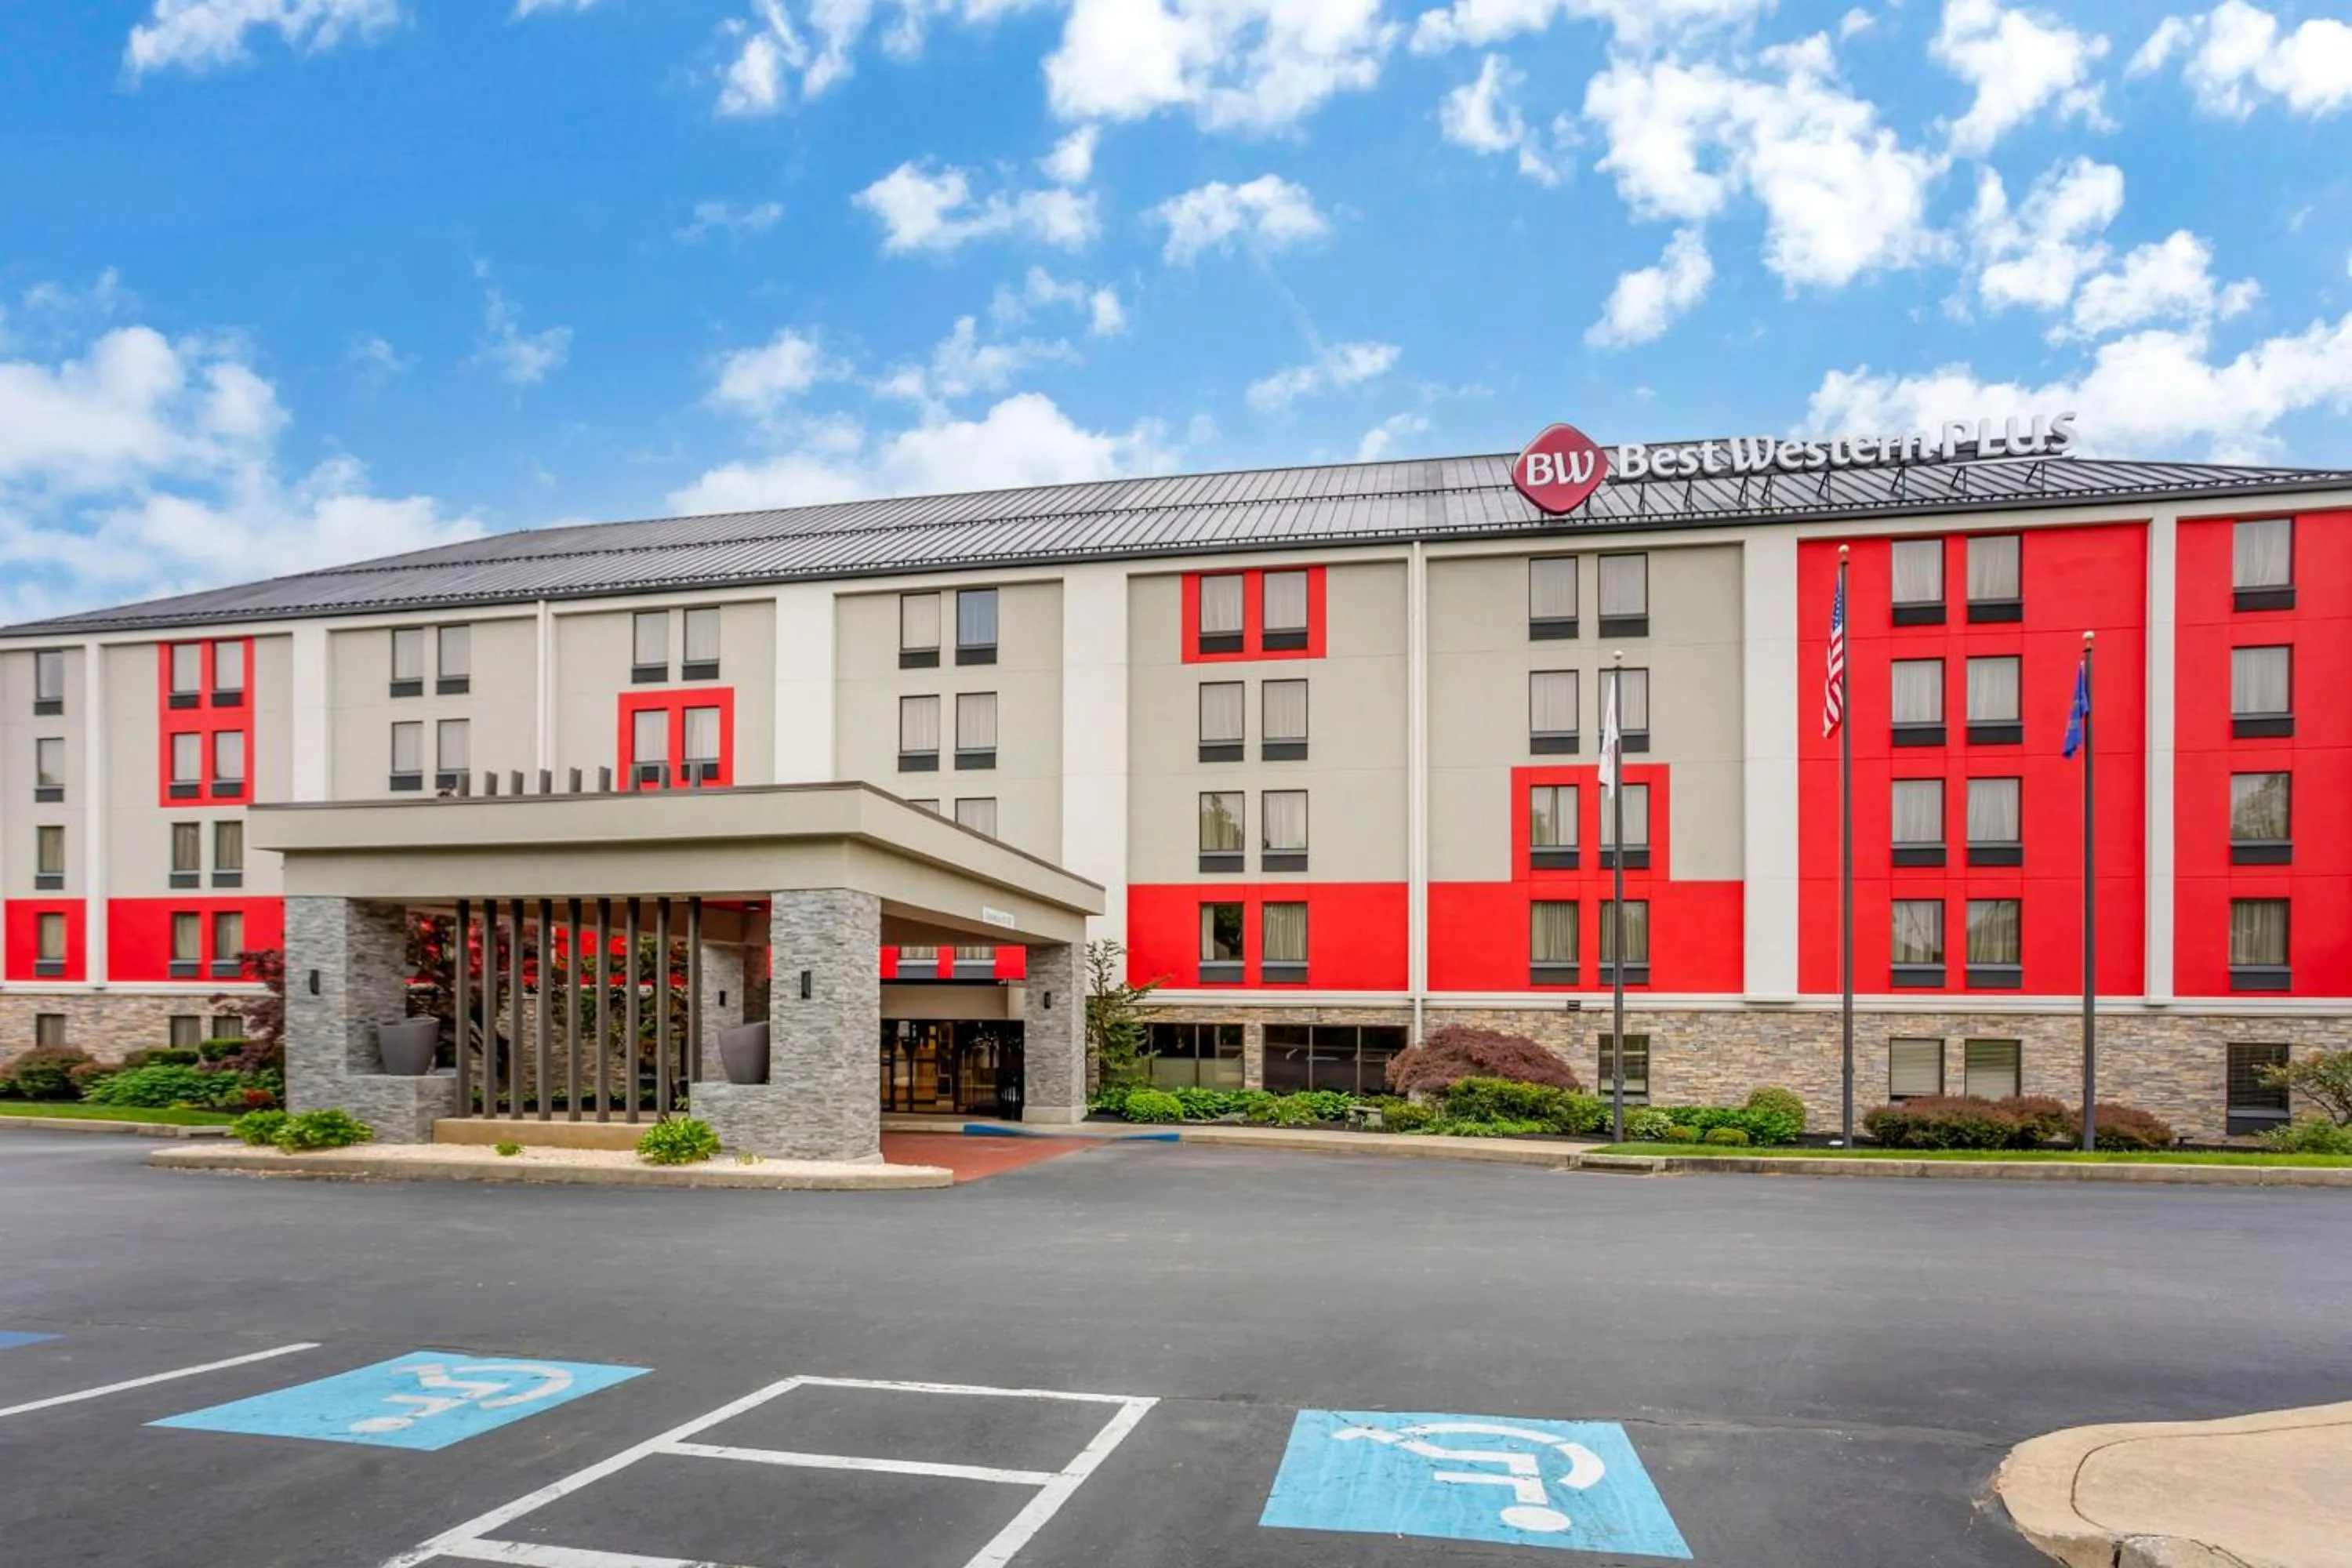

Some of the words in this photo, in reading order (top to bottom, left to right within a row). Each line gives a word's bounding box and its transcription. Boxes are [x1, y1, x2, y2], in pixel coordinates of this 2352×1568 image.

[1526, 449, 1595, 486] BW
[1617, 441, 1724, 479] Best
[1730, 431, 1933, 473] Western
[1942, 411, 2077, 459] PLUS
